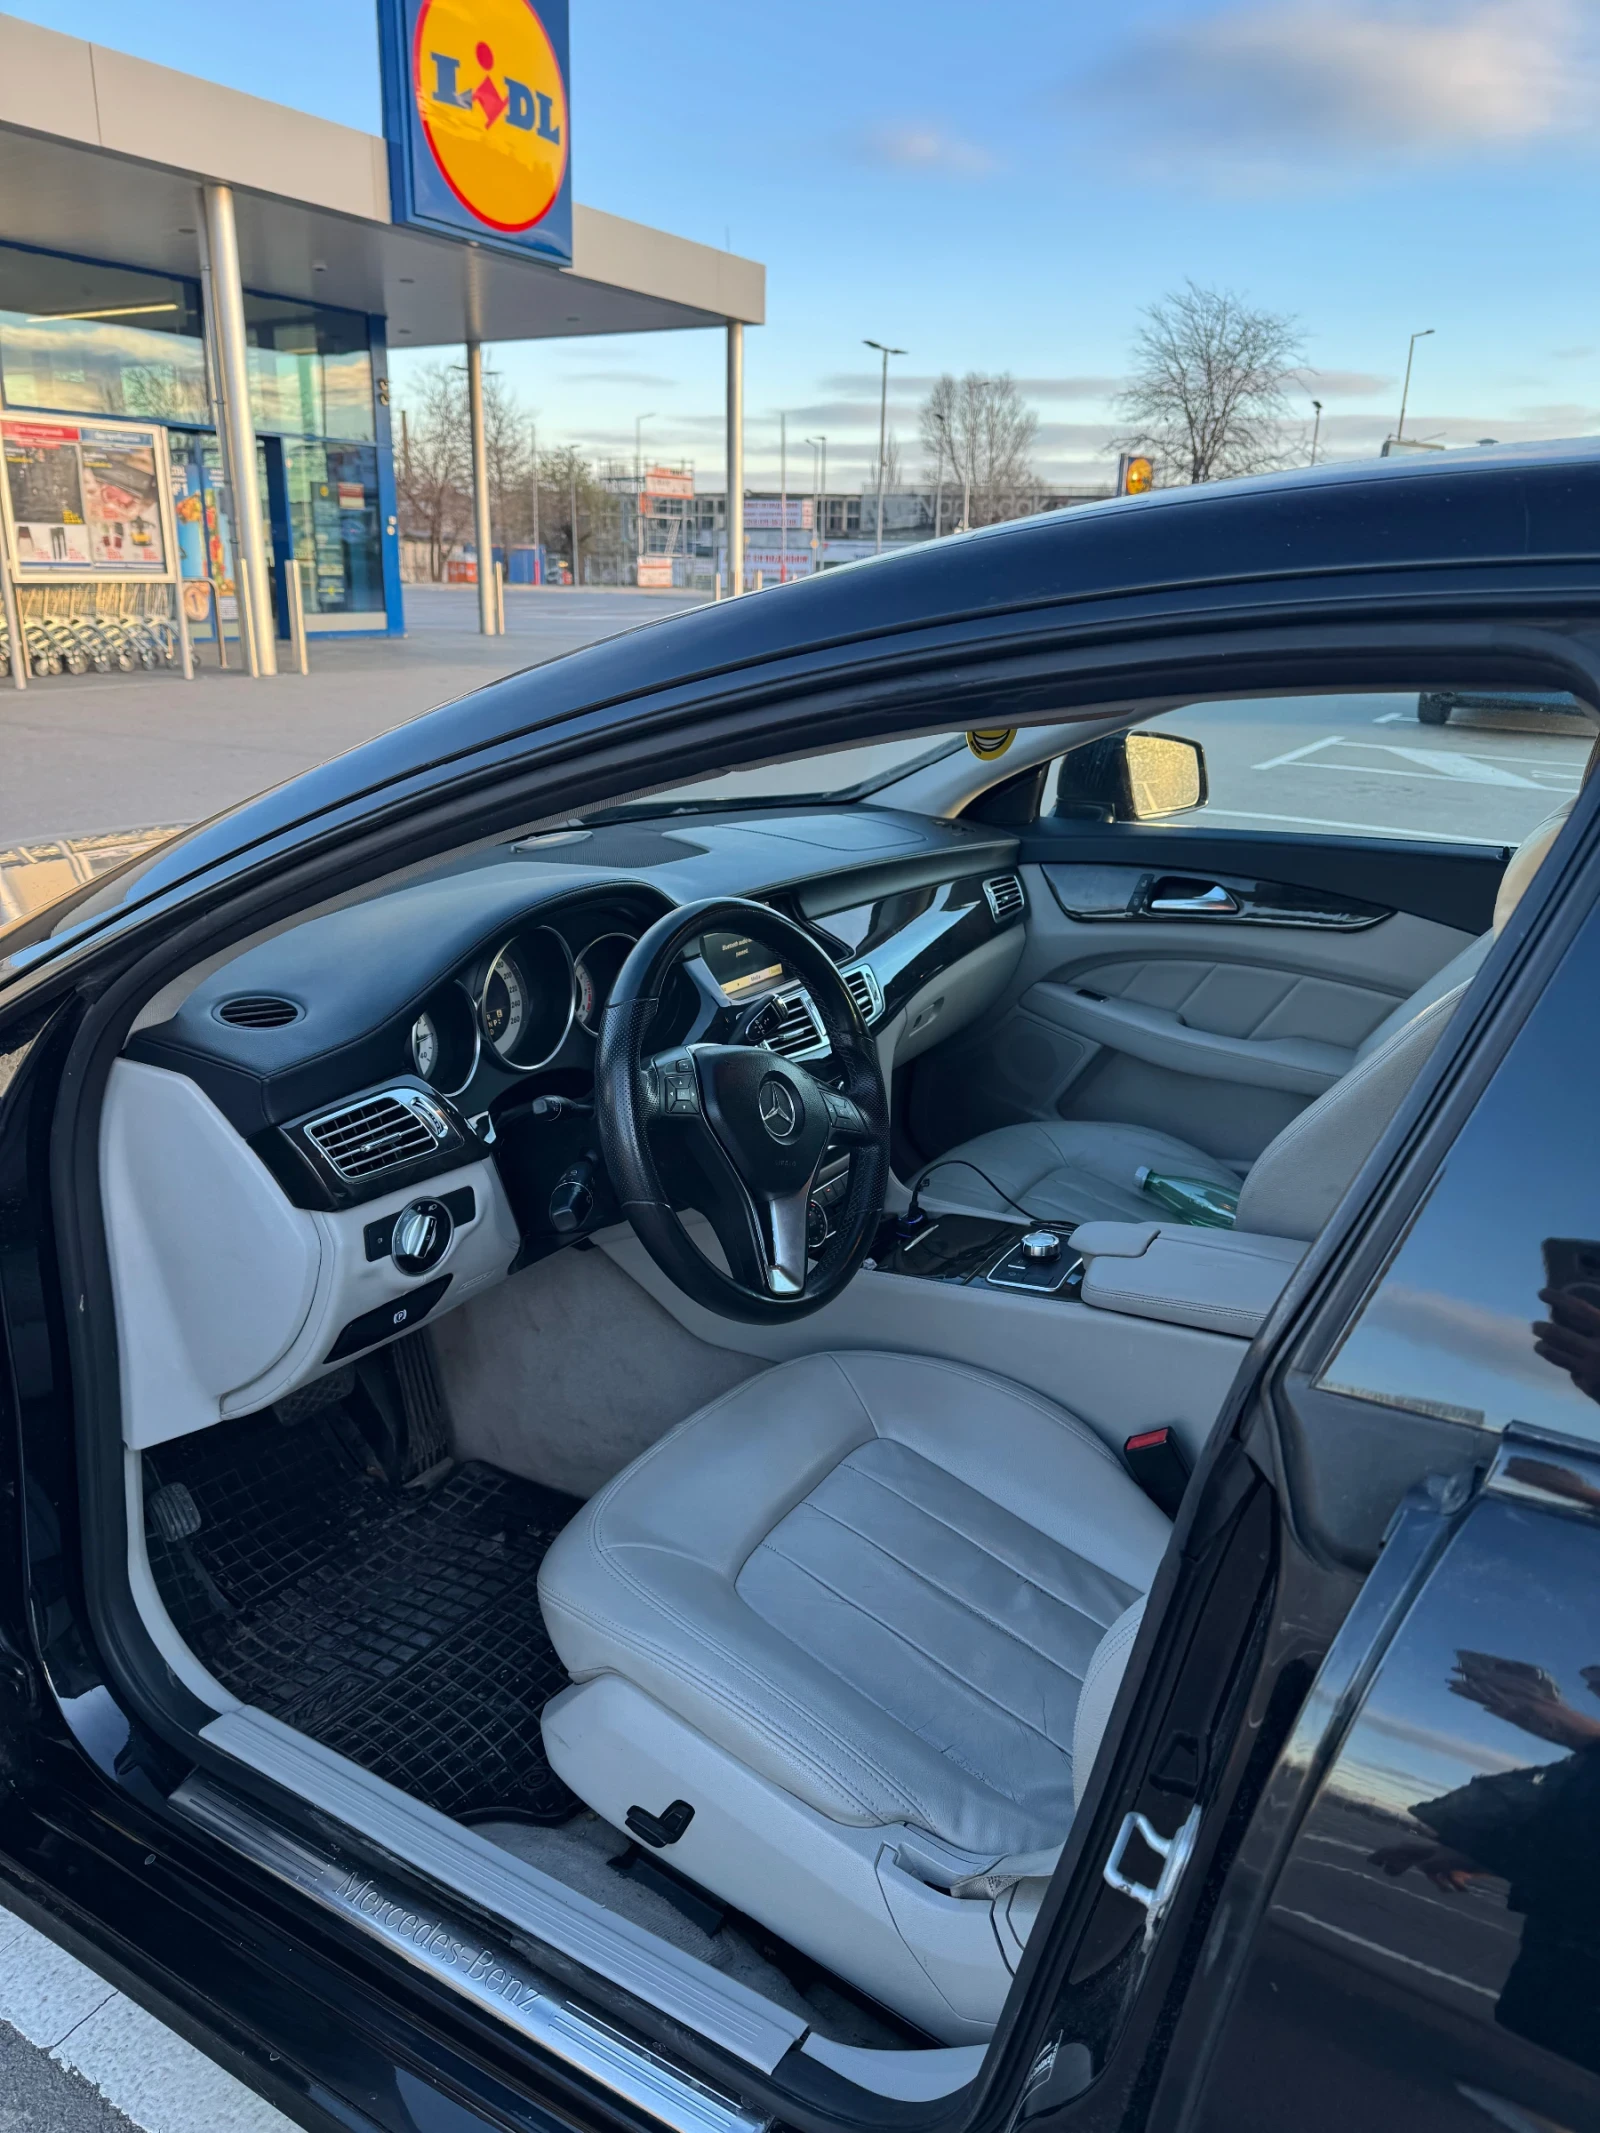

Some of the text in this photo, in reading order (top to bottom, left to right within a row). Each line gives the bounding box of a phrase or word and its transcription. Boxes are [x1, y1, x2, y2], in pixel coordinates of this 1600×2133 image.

[509, 984, 518, 994] 220
[511, 999, 521, 1009] 240
[510, 1015, 520, 1025] 260
[333, 1871, 541, 2014] Mercedes-Benz
